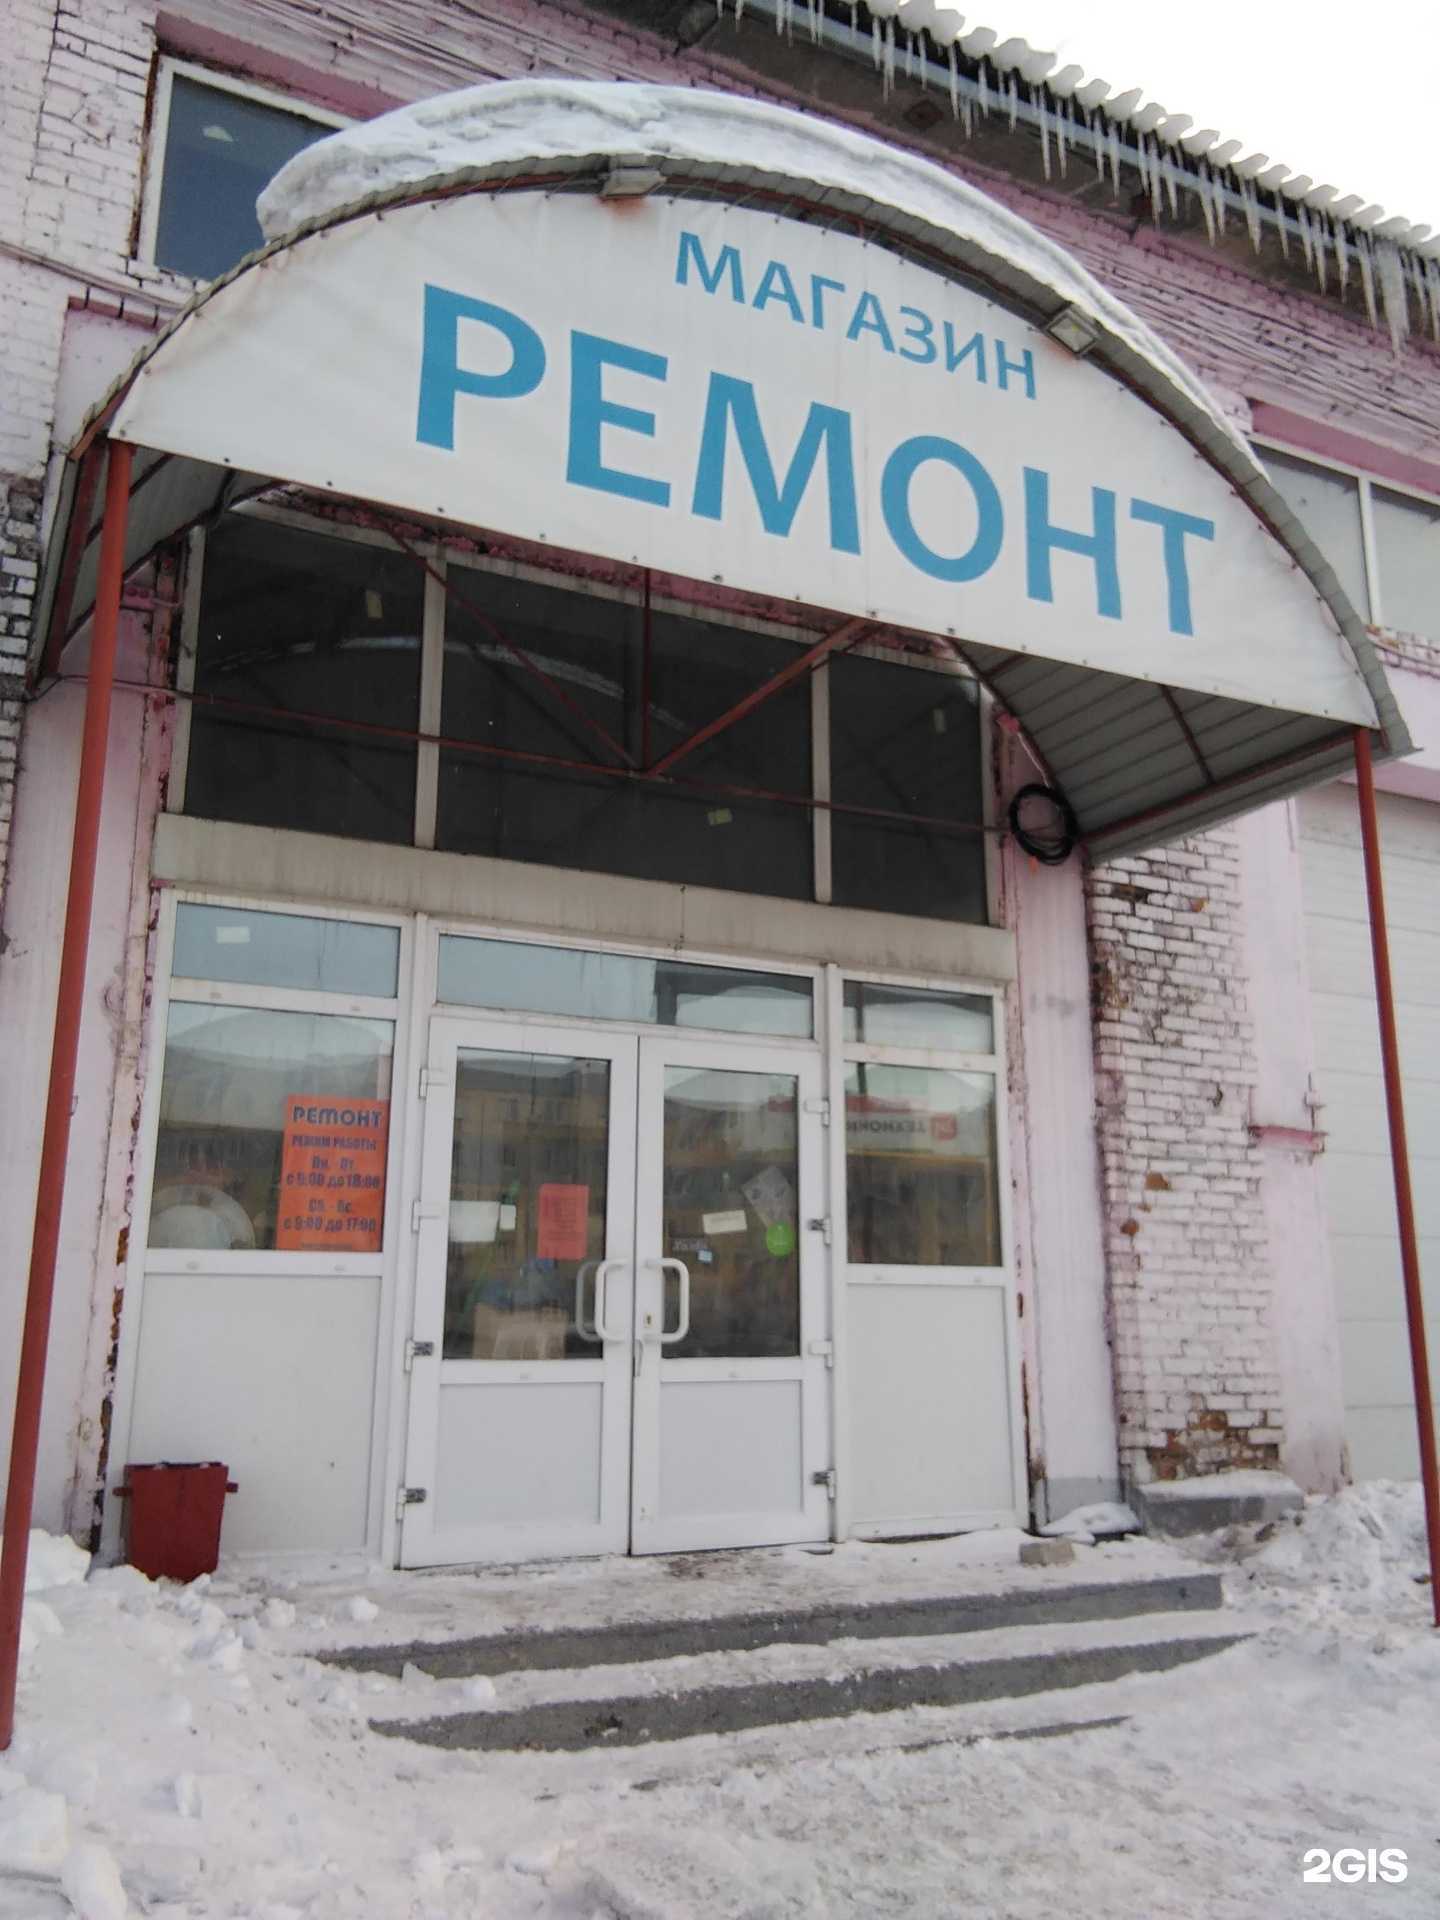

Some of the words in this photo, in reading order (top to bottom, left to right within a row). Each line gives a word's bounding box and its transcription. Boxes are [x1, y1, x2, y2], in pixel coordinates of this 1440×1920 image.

[674, 231, 1039, 399] МАГАЗИН
[416, 282, 1215, 637] РЕМОНТ
[293, 1105, 382, 1127] РЕМОНТ
